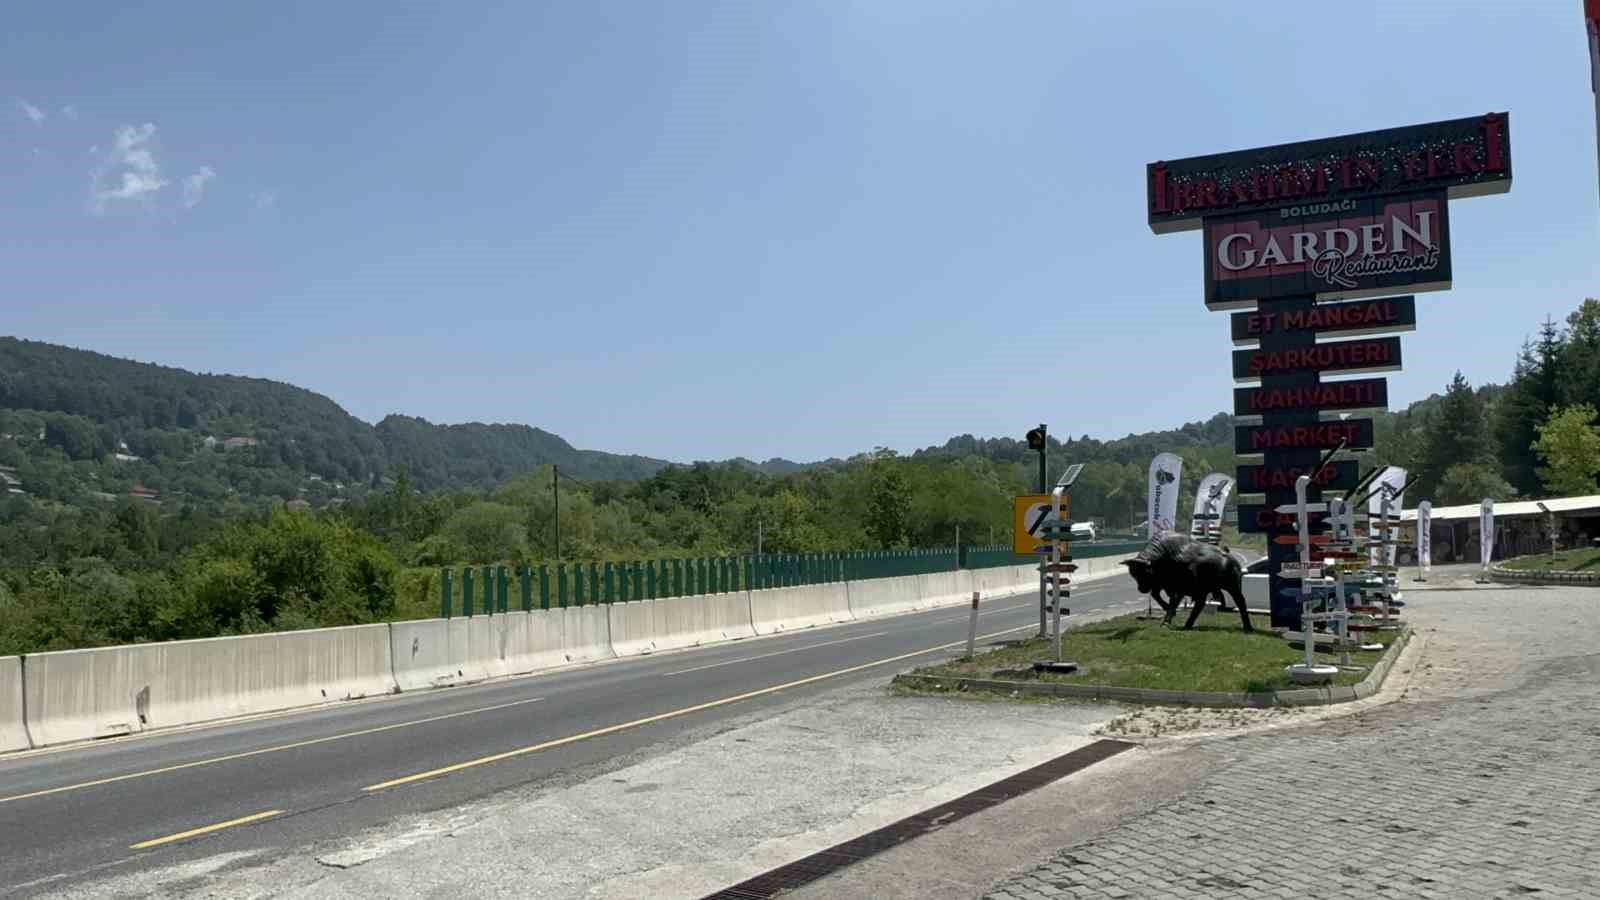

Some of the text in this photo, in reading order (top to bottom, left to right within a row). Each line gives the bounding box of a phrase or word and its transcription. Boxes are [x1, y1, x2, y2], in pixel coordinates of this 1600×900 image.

[1217, 211, 1435, 271] GARDEN
[1312, 246, 1440, 287] Restaurant
[1248, 302, 1399, 333] ET MANGAL
[1250, 382, 1376, 409] KAHVALTI
[1253, 424, 1360, 448] MARKET
